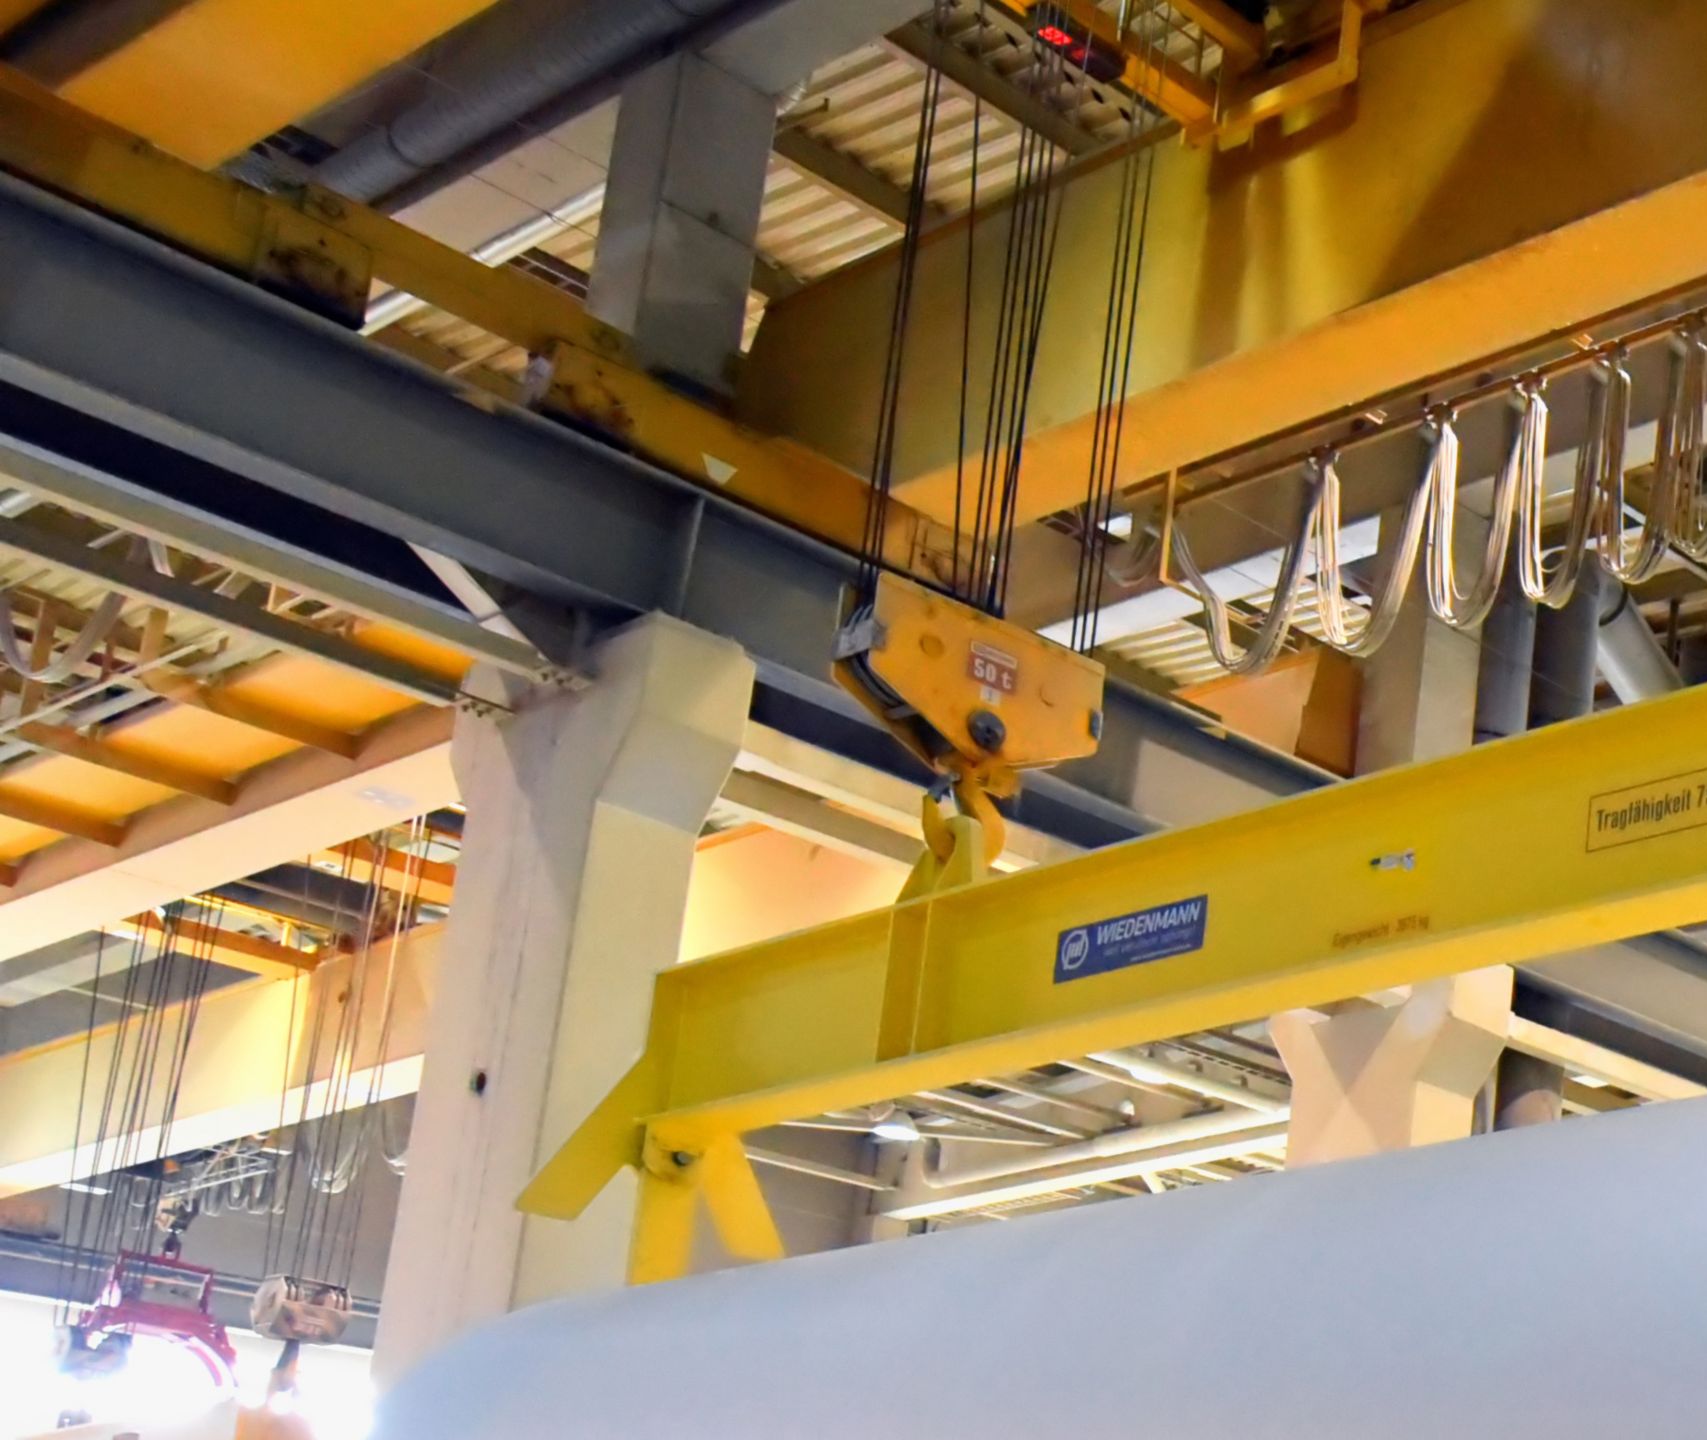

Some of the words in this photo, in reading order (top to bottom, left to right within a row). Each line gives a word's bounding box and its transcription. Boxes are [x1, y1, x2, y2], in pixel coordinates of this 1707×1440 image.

[973, 657, 997, 683] 50
[1001, 671, 1013, 690] t
[1596, 788, 1692, 832] Tragfähigkeit
[1096, 902, 1201, 945] WIEDENMANN
